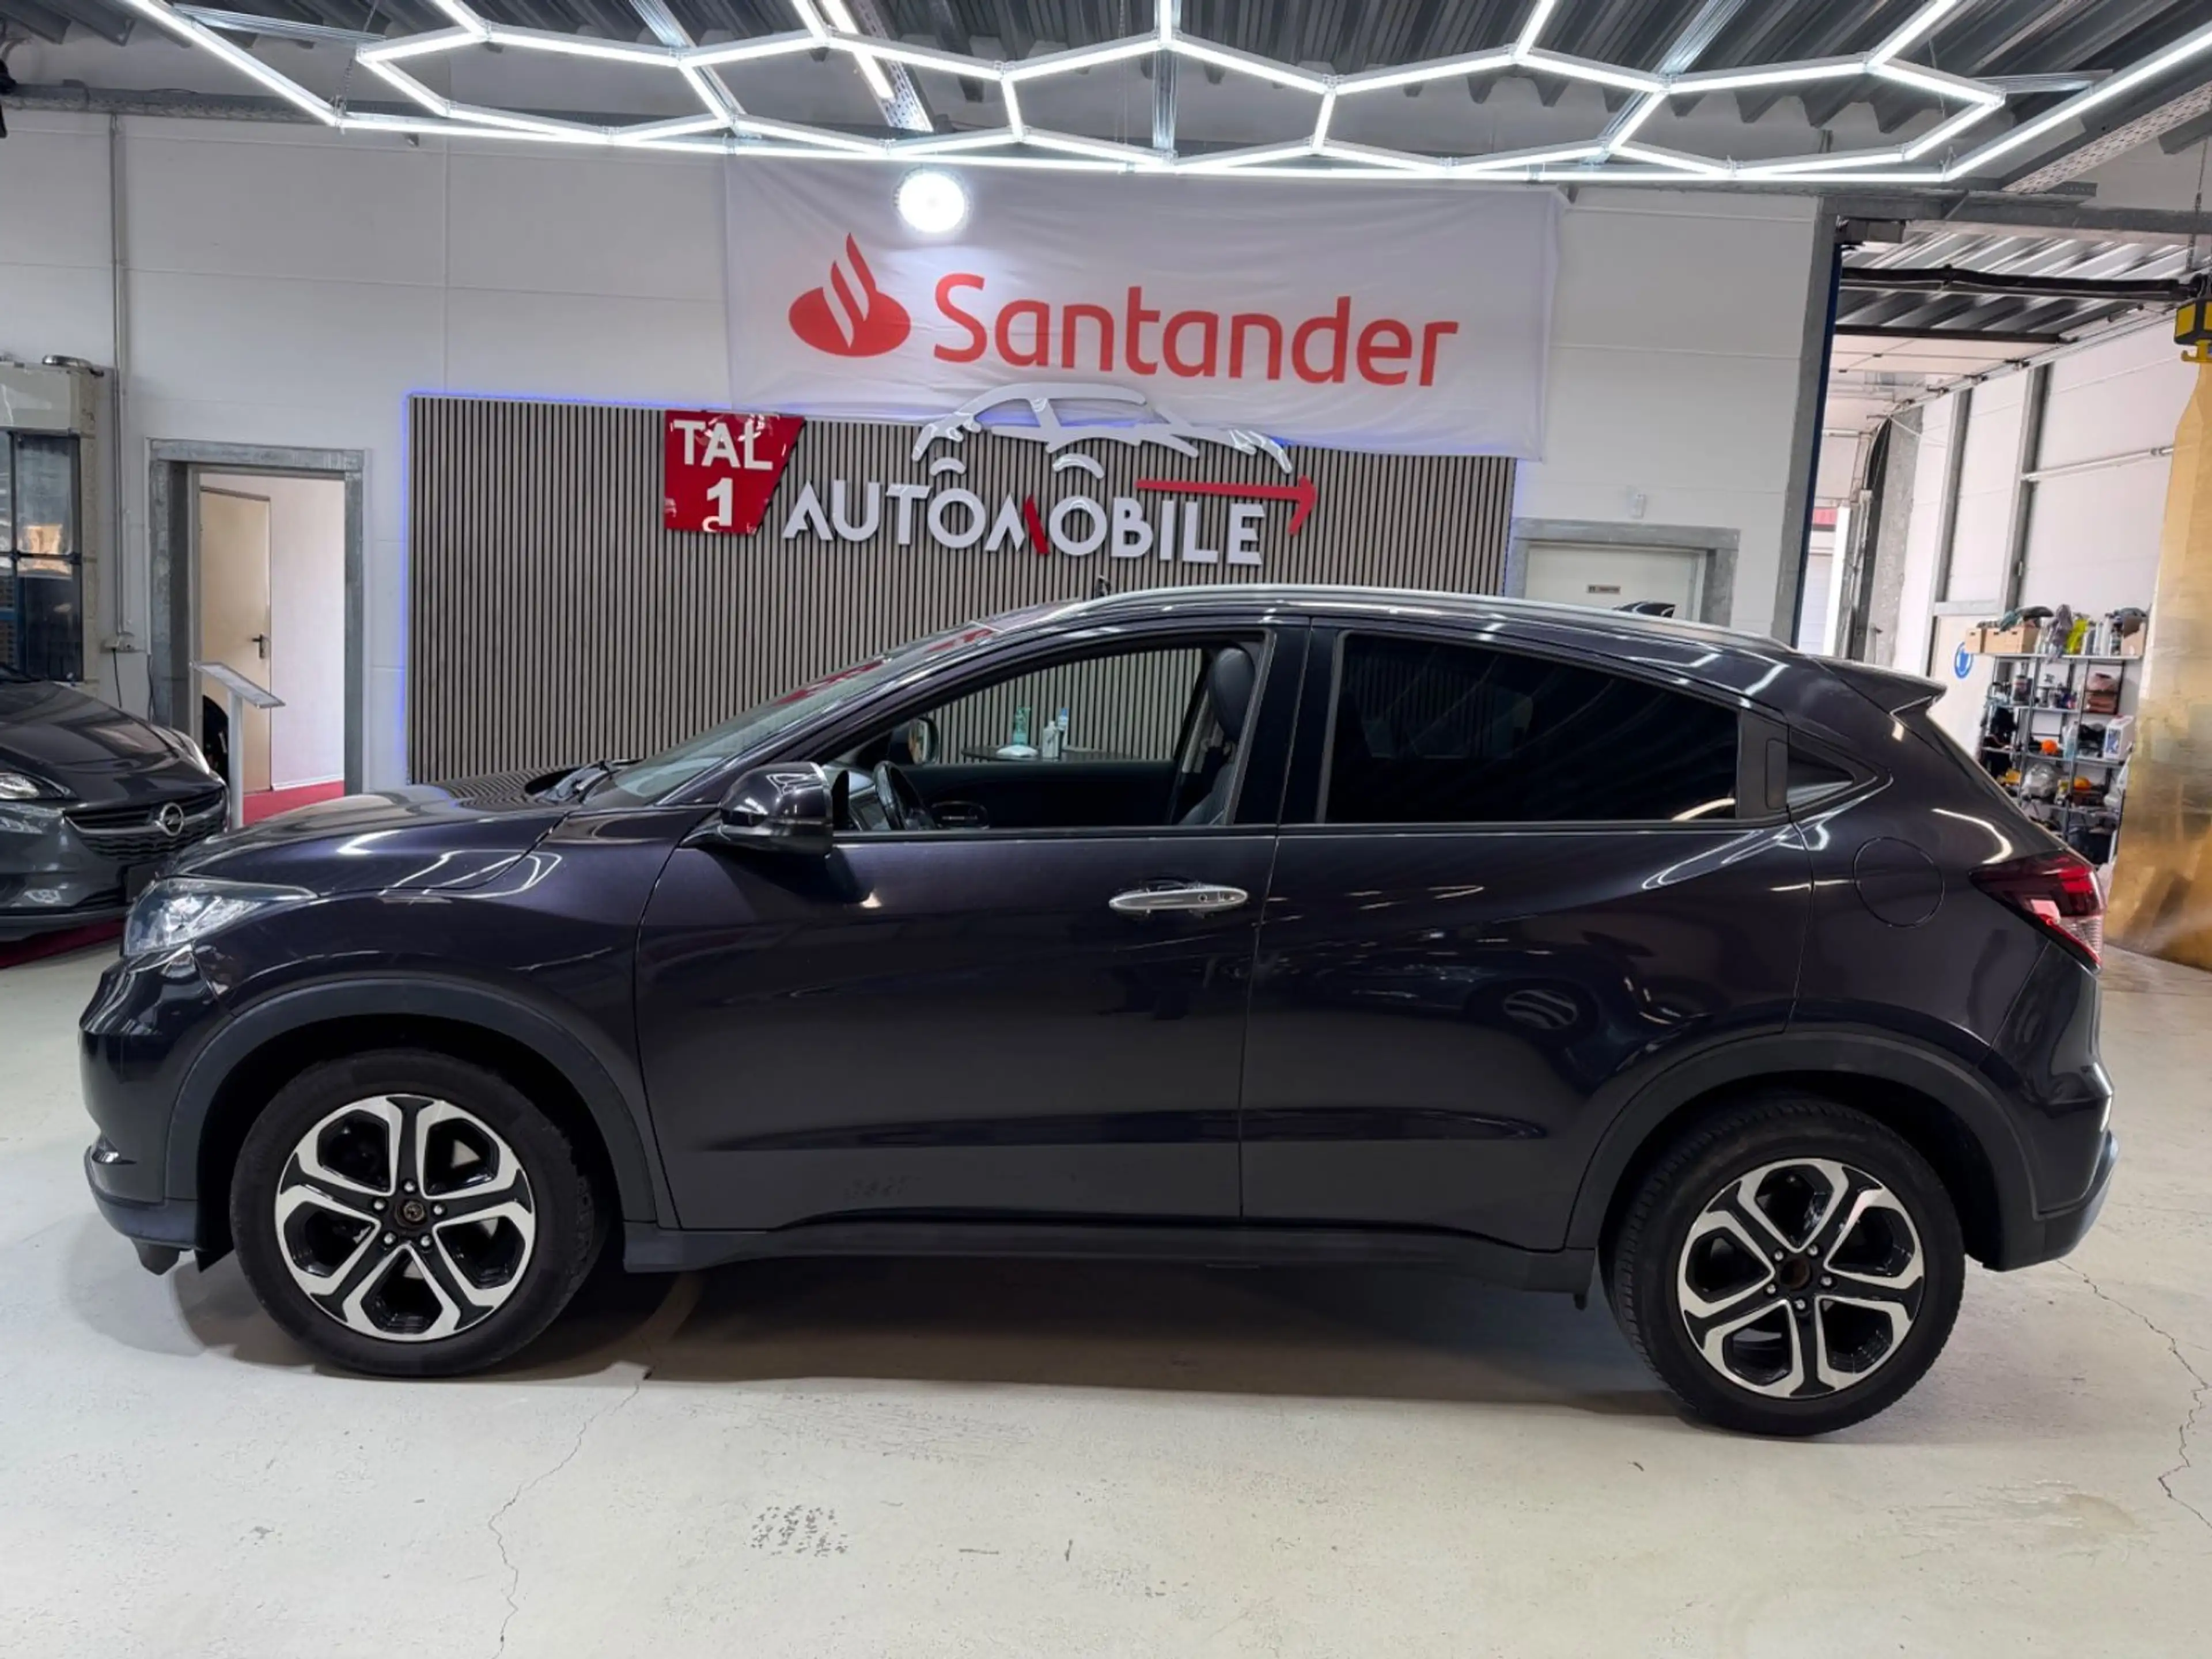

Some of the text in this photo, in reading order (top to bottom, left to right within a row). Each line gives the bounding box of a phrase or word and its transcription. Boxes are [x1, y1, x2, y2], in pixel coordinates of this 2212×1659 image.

[933, 272, 1459, 387] Santander
[673, 419, 774, 471] TAL
[706, 477, 733, 527] 1
[782, 479, 1266, 566] AUTOMOBILE
